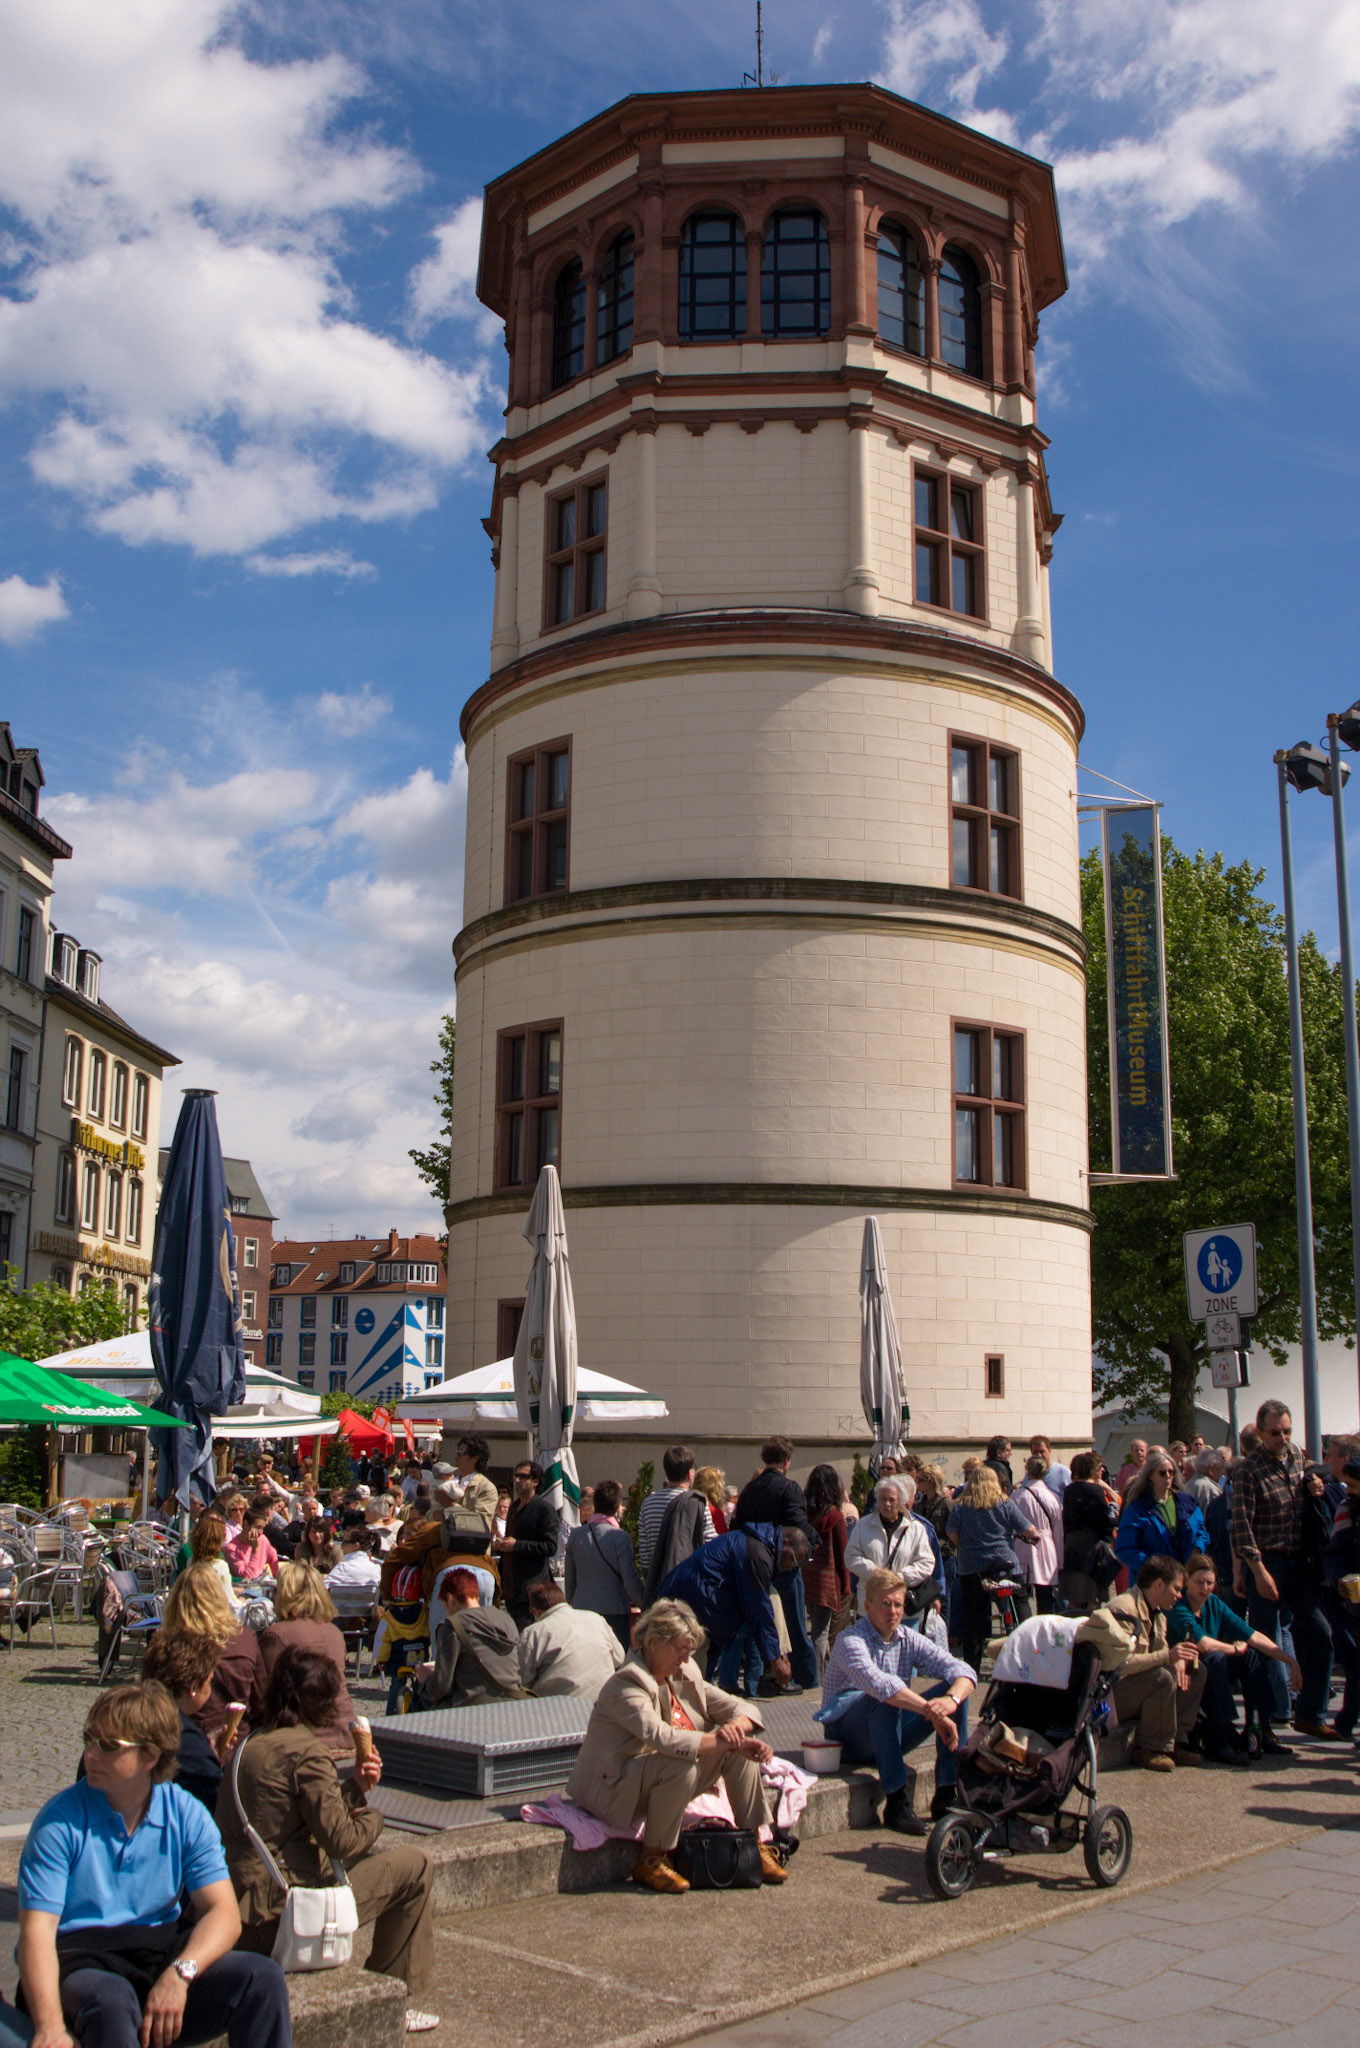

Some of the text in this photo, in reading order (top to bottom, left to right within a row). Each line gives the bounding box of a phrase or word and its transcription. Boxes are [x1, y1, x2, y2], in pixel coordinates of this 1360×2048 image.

[1123, 888, 1148, 1106] SchifffahrtMuseum
[73, 1118, 145, 1171] Bitburger Pils
[1205, 1296, 1237, 1312] ZONE
[66, 1357, 141, 1366] Bitburger
[56, 1404, 142, 1416] Heineken
